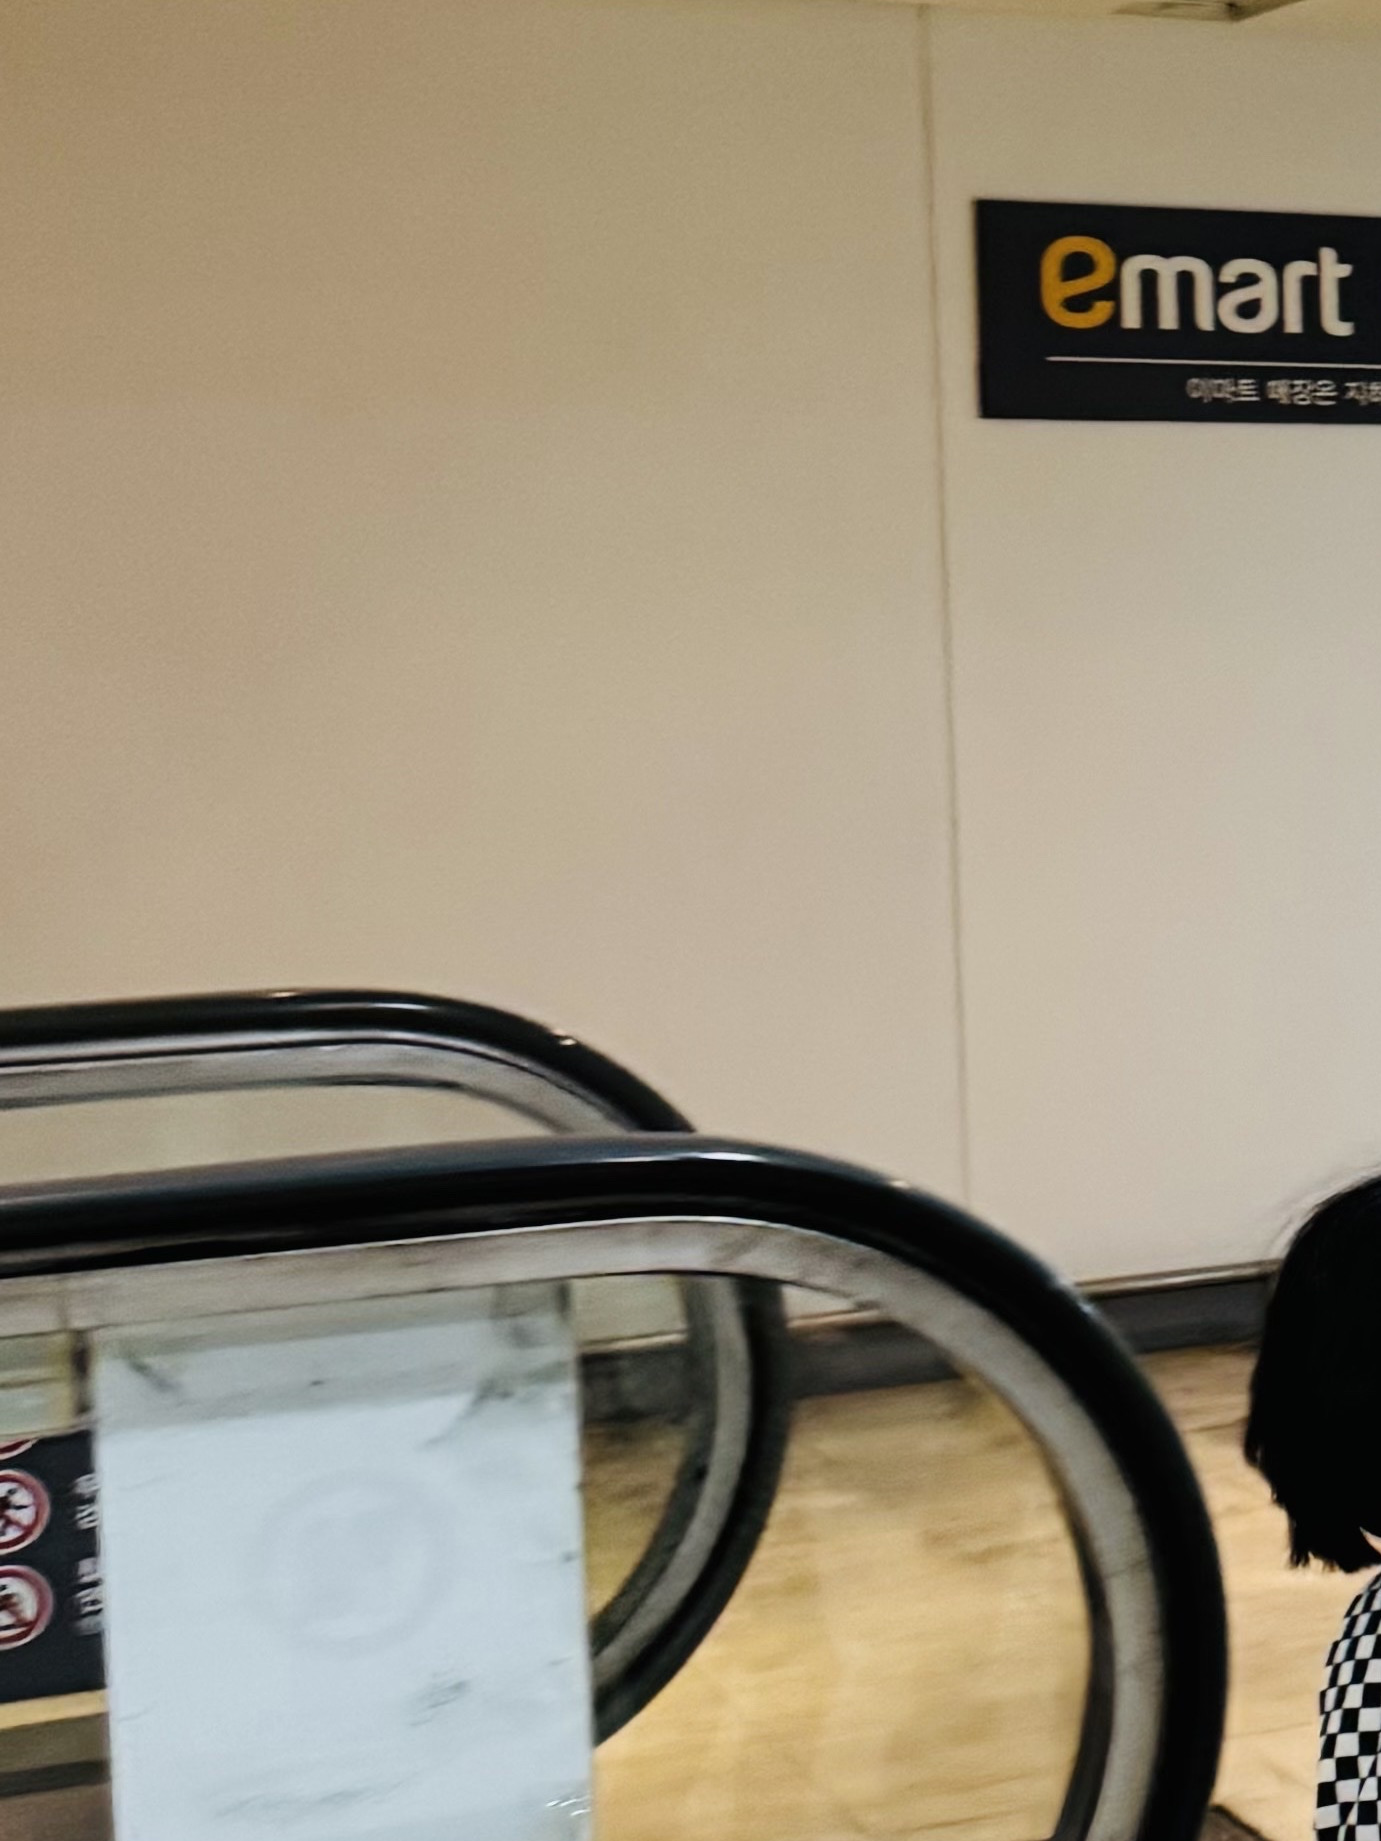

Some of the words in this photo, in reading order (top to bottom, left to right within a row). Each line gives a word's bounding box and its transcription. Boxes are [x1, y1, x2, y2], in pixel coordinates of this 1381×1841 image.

[1040, 235, 1355, 337] emart
[1185, 377, 1261, 404] 이마트
[1265, 379, 1338, 407] 매장은
